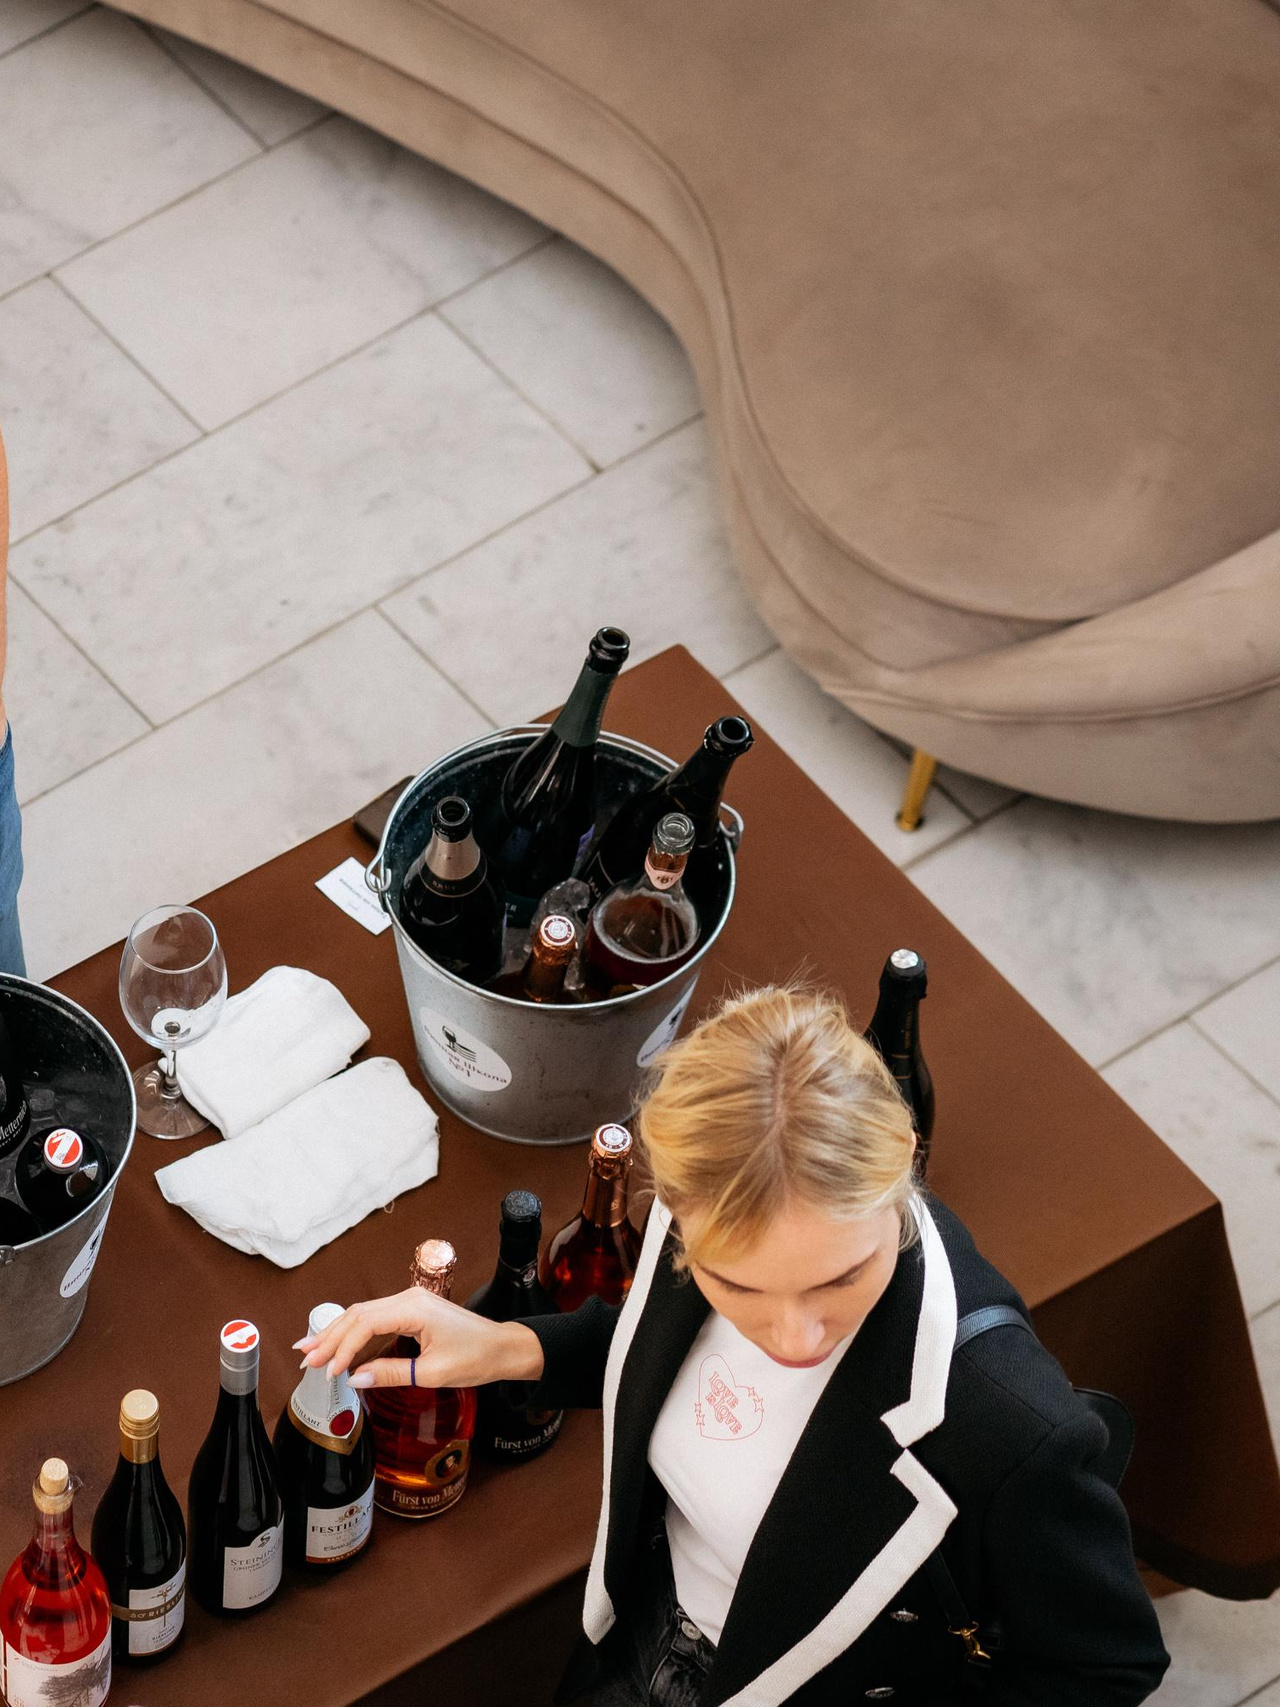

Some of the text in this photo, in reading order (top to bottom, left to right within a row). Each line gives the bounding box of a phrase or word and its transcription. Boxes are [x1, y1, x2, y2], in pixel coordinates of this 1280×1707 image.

[463, 1061, 508, 1084] Школа
[709, 1370, 740, 1410] LOVE
[494, 1436, 522, 1450] Fürst
[523, 1435, 541, 1448] von
[392, 1489, 420, 1506] Fürst
[421, 1494, 440, 1505] von
